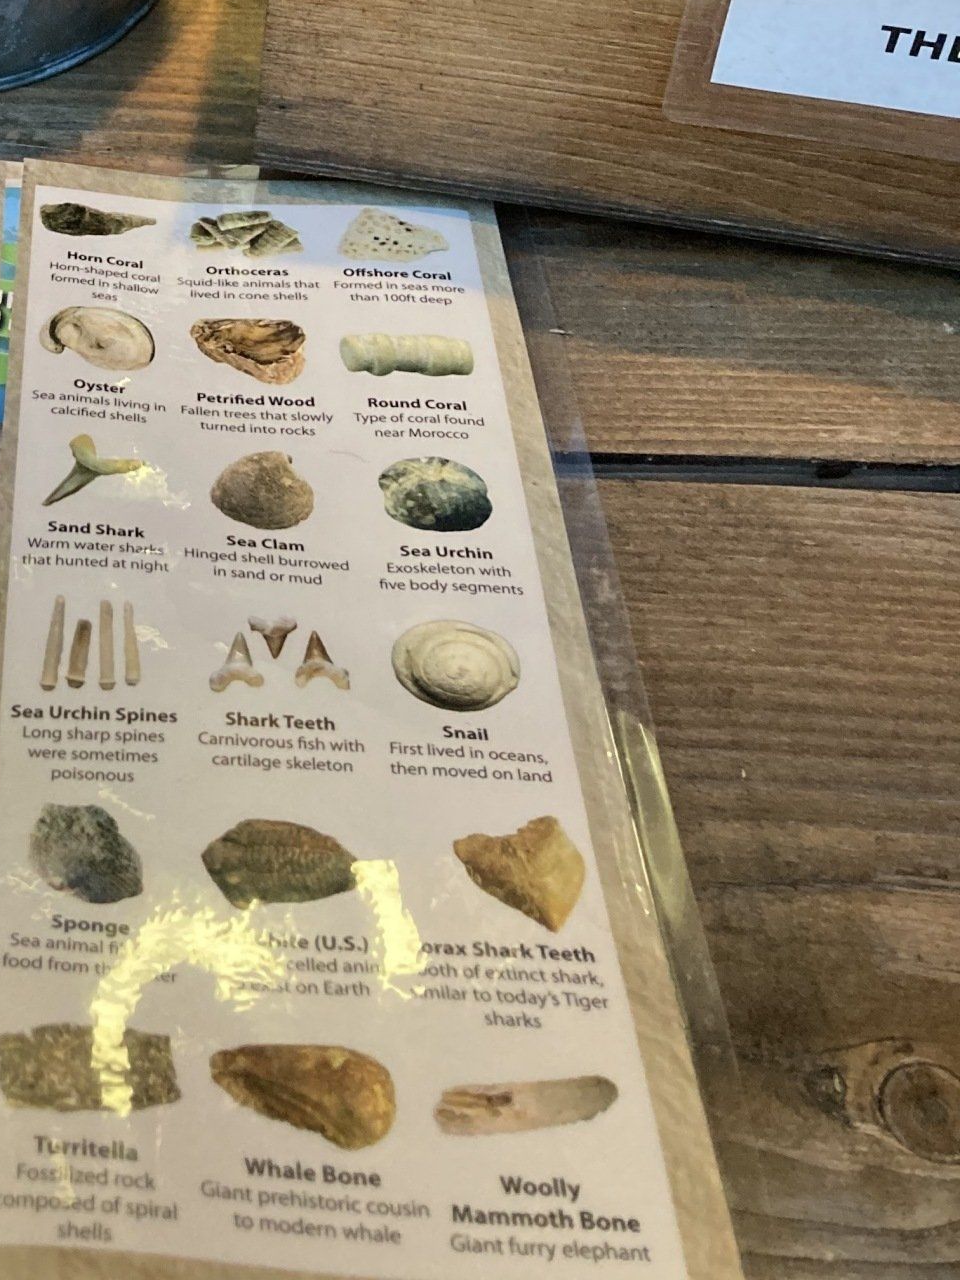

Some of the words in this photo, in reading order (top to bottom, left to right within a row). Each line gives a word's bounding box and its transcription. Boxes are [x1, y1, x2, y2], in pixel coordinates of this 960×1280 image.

[67, 250, 102, 263] Horn
[106, 256, 143, 268] Coral
[205, 265, 288, 276] Orthoceras
[342, 267, 408, 278] Offshore
[411, 269, 451, 280] Coral
[333, 280, 382, 289] Formed
[385, 281, 398, 289] in
[401, 283, 428, 291] seas
[431, 285, 464, 294] more
[349, 292, 379, 301] than
[383, 293, 416, 303] 100ft
[418, 294, 452, 306] deep
[73, 378, 125, 393] Oyster
[196, 392, 264, 405] Petrified
[268, 395, 315, 407] Wood
[367, 397, 421, 408] Round
[424, 399, 466, 411] Coral
[47, 520, 90, 534] Sand
[95, 523, 144, 538] Shark
[226, 535, 256, 547] Sea
[260, 538, 304, 551] Clam
[399, 545, 431, 556] Sea
[435, 545, 492, 559] Urchin
[10, 704, 43, 718] Sea
[49, 705, 110, 720] Urchin
[115, 707, 177, 725] Spines
[225, 711, 279, 728] Shark
[282, 714, 335, 731] Teeth
[442, 725, 488, 740] Snail
[50, 913, 130, 938] Sponge
[472, 941, 533, 959] Shark
[535, 943, 595, 963] Teeth
[244, 1157, 316, 1182] Whale
[321, 1164, 381, 1188] Bone
[498, 1175, 580, 1203] Woolly
[451, 1203, 574, 1229] Mammoth
[578, 1210, 640, 1233] Bone
[449, 1233, 503, 1255] Giant
[507, 1235, 556, 1262] furry
[561, 1239, 651, 1263] elephant
